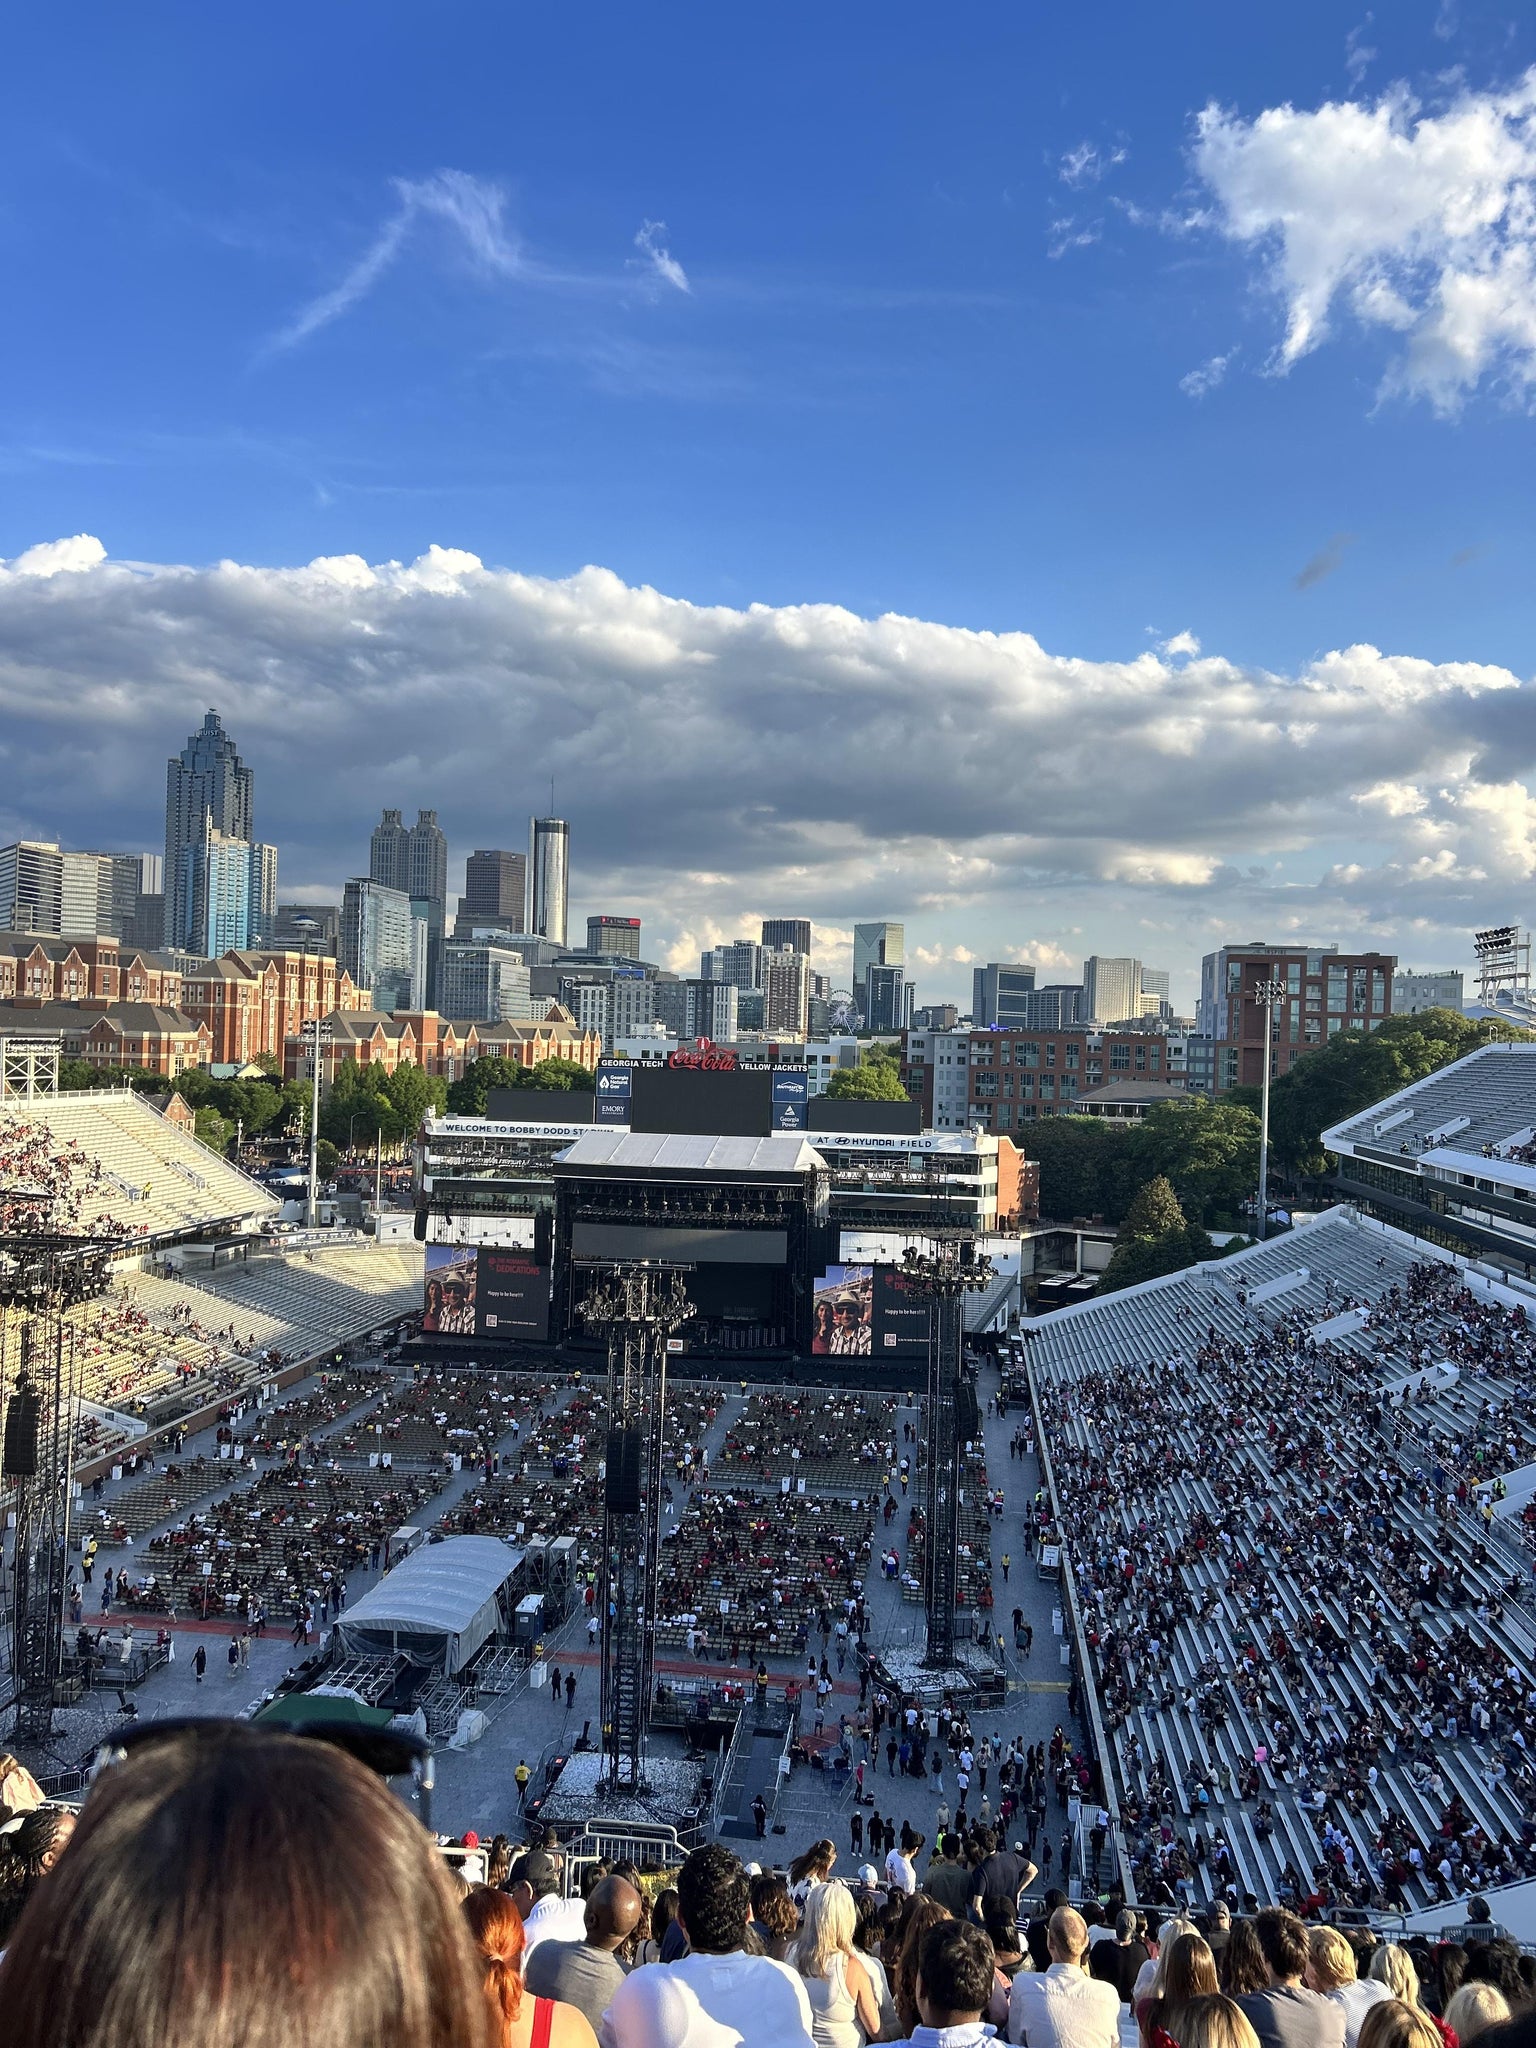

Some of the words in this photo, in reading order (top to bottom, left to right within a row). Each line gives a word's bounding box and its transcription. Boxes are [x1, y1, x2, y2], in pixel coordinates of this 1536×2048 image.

[601, 1058, 639, 1068] GEORGIA
[641, 1060, 664, 1068] TECH
[739, 1062, 771, 1071] YELLOW
[772, 1063, 808, 1072] JACKETS
[779, 1115, 800, 1123] Georgia
[445, 1124, 492, 1133] WELCOME
[494, 1125, 507, 1133] TO
[509, 1126, 541, 1134] BOBBY
[543, 1127, 570, 1135] DODD
[816, 1136, 830, 1144] AT
[852, 1138, 895, 1147] HYUNDAI
[900, 1140, 932, 1148] FIELD
[496, 1265, 541, 1276] DEDICATIONS
[884, 1308, 898, 1316] Happy
